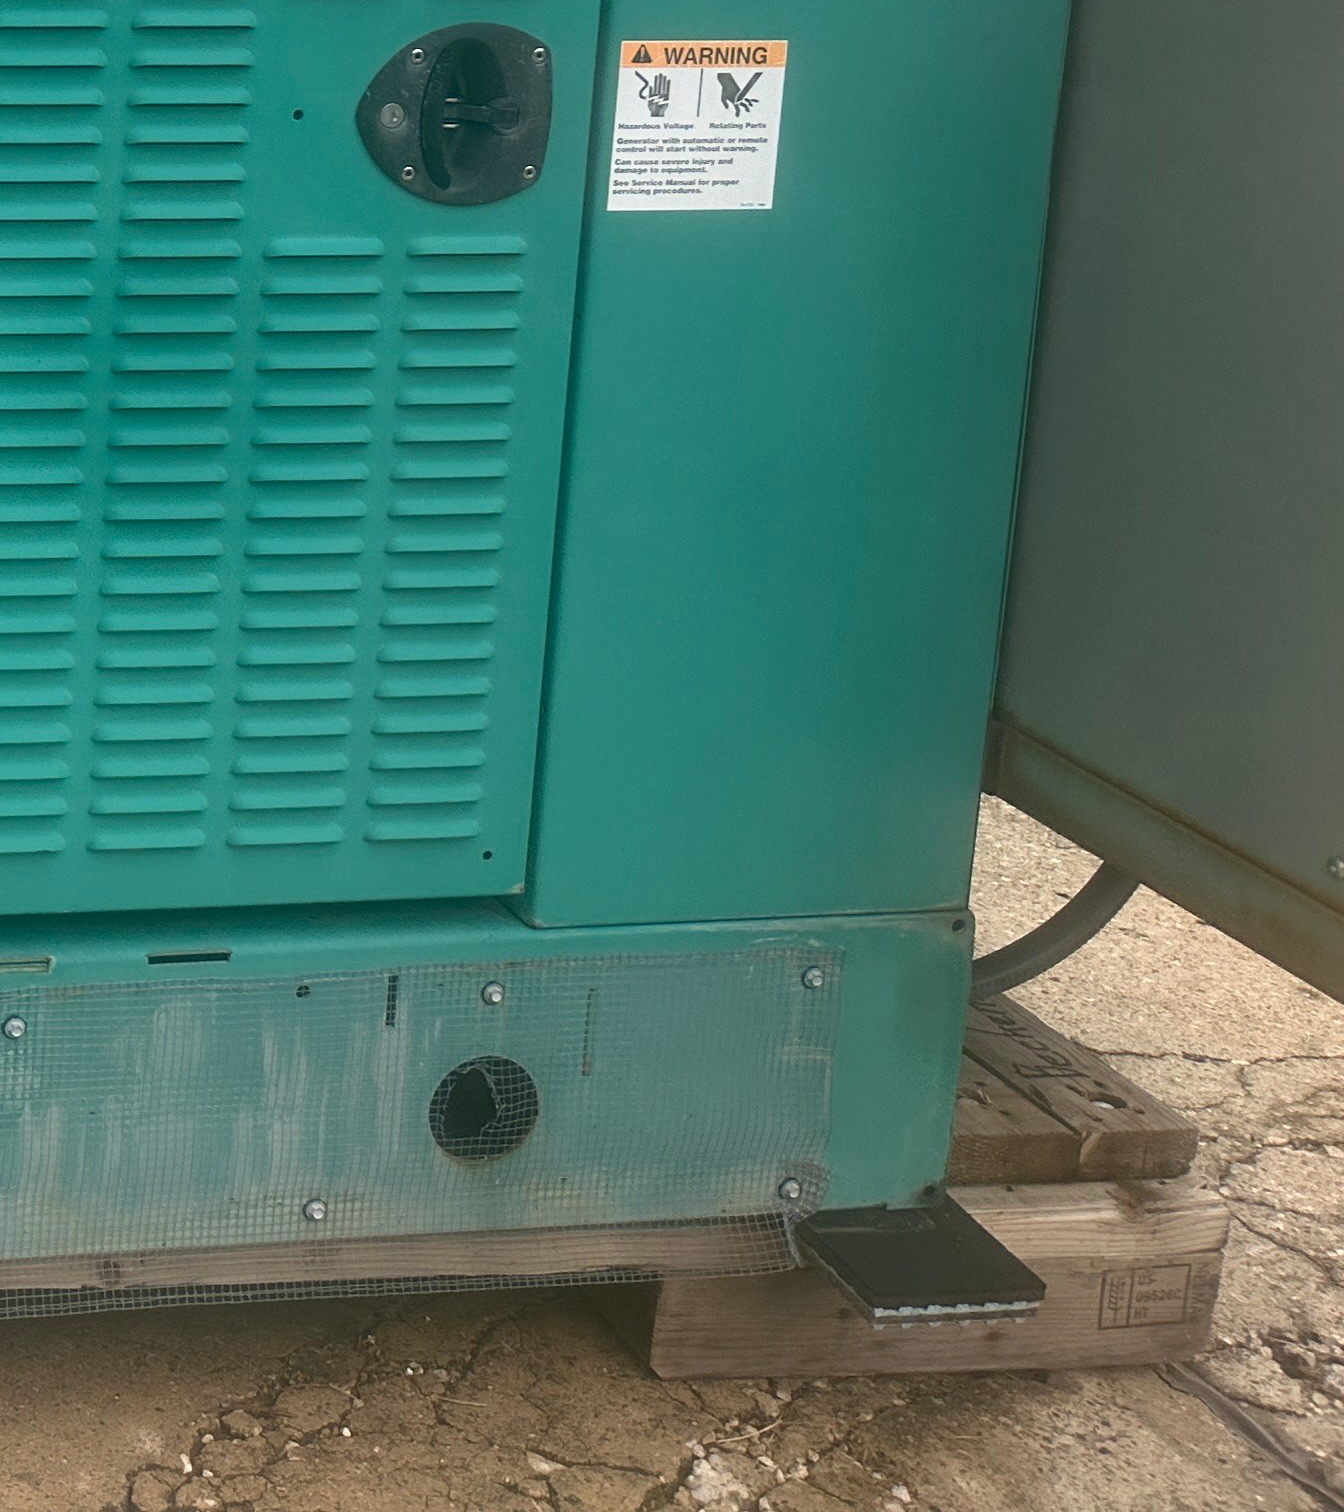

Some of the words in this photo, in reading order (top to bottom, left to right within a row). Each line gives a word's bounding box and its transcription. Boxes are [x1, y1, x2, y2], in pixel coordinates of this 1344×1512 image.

[664, 47, 768, 65] WARNING
[618, 122, 661, 130] Hazardous
[663, 122, 694, 131] Voltage
[709, 122, 743, 131] Rotating
[616, 137, 660, 145] Generator
[616, 145, 646, 153] control
[648, 145, 664, 153] will
[666, 145, 686, 153] start
[688, 145, 720, 153] without
[722, 145, 759, 154] warning.
[615, 158, 632, 166] Can
[692, 158, 715, 166] injury
[717, 157, 733, 165] and
[614, 167, 647, 175] damage
[661, 167, 707, 175] equipment.
[613, 179, 629, 187] See
[712, 179, 740, 187] proper
[612, 187, 651, 196] servicing
[653, 187, 703, 195] procedures.
